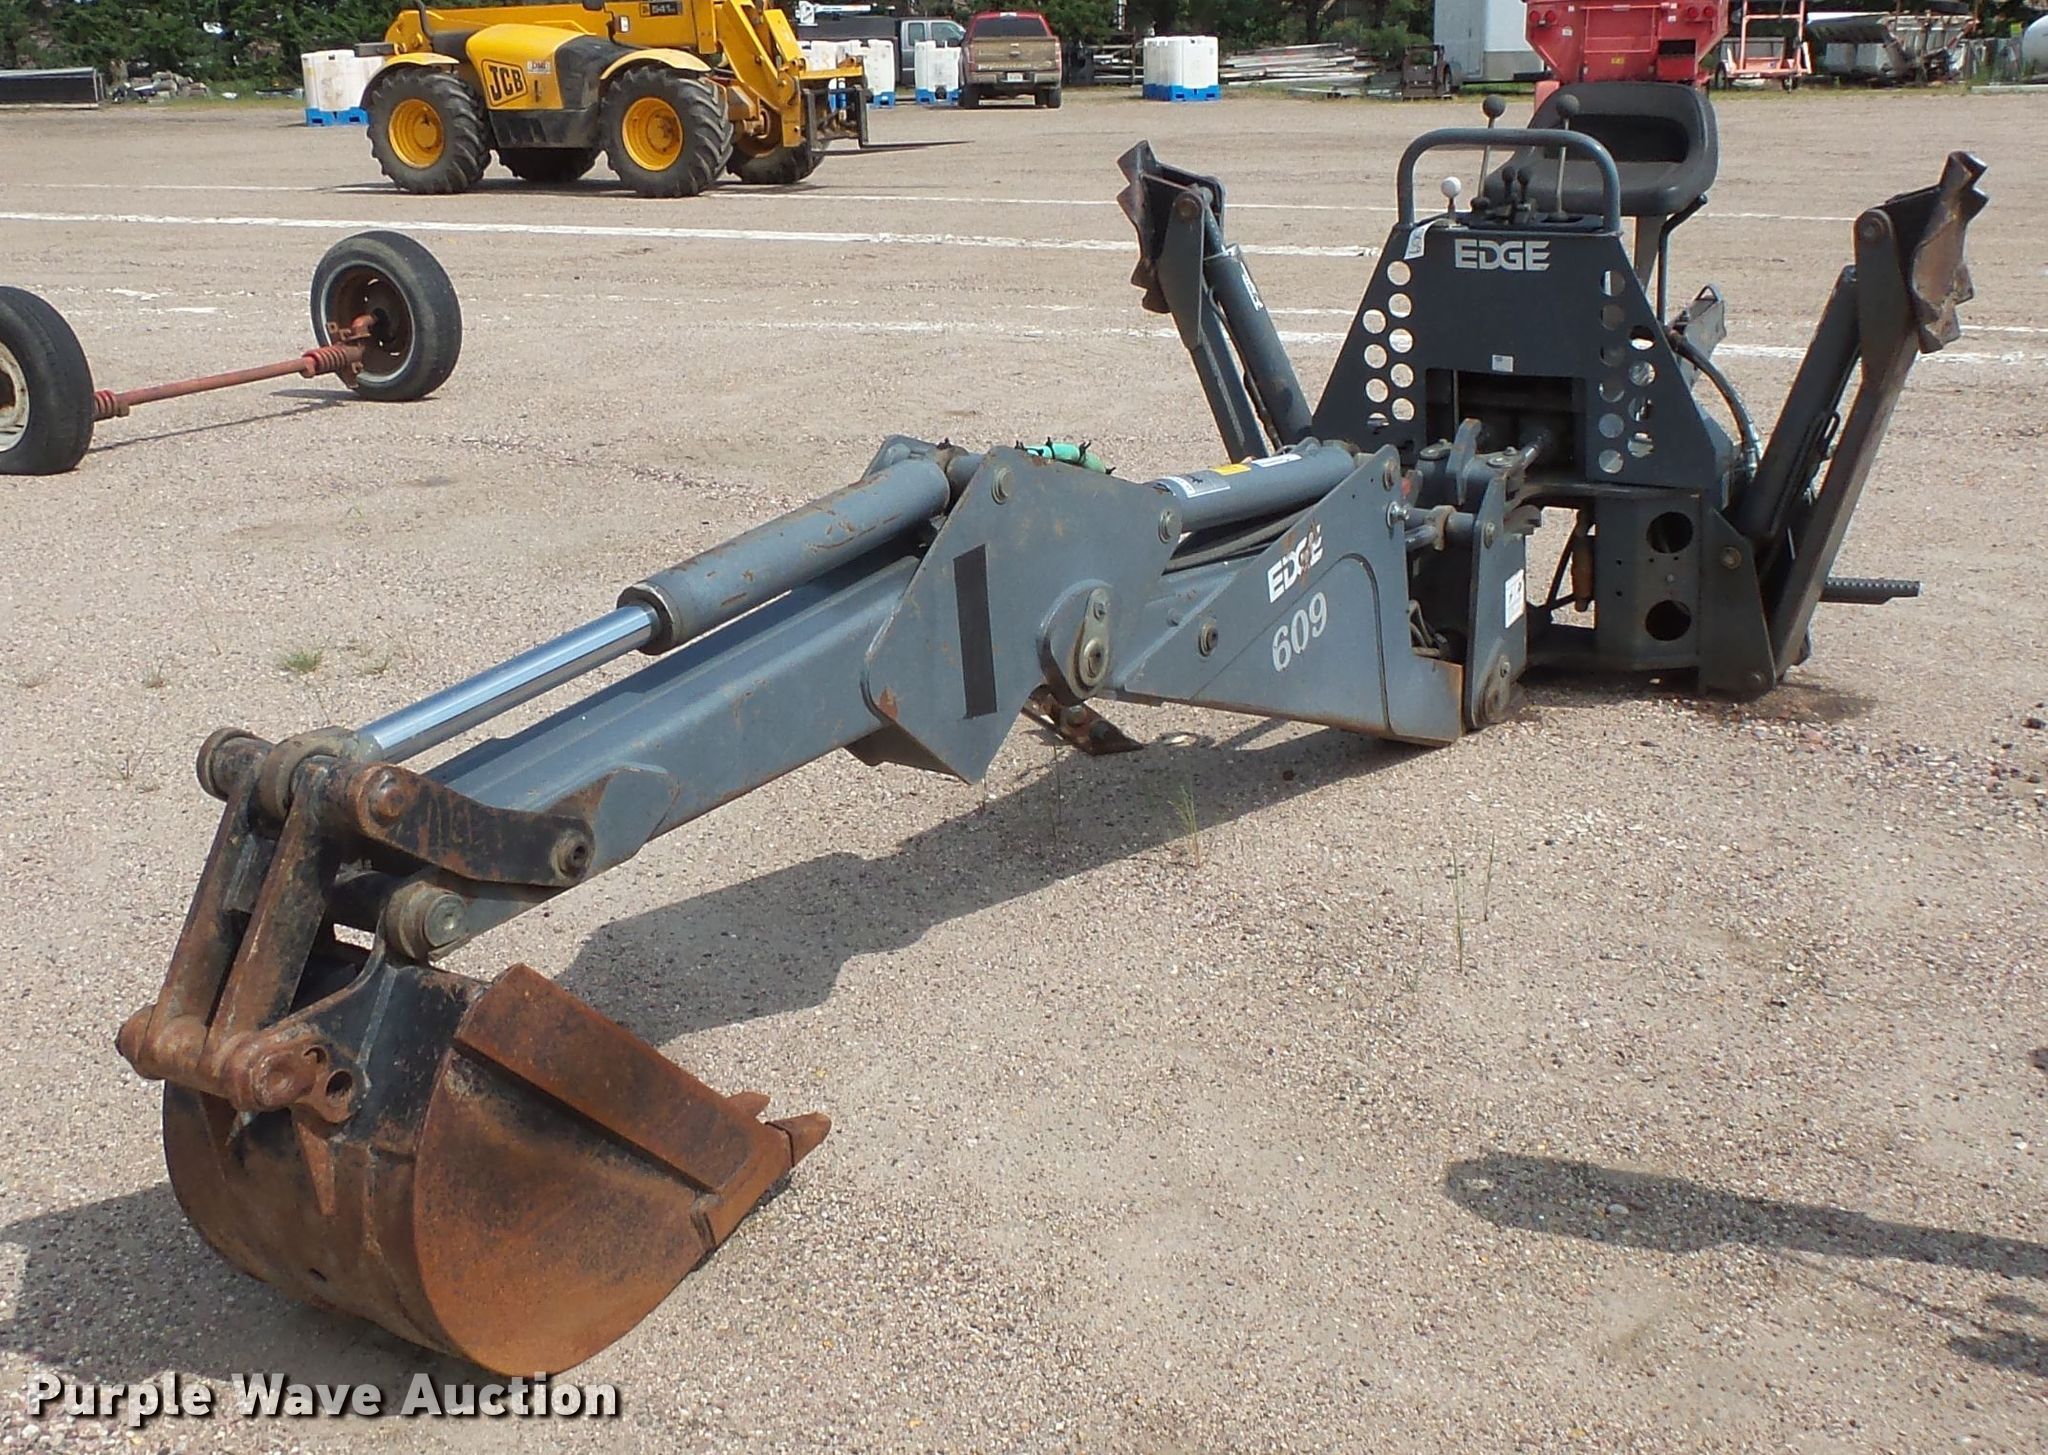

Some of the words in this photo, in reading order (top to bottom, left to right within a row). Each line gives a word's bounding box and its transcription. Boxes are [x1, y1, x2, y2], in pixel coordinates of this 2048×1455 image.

[488, 64, 524, 101] JCB
[1455, 238, 1550, 271] EDGE
[1272, 592, 1327, 672] 609
